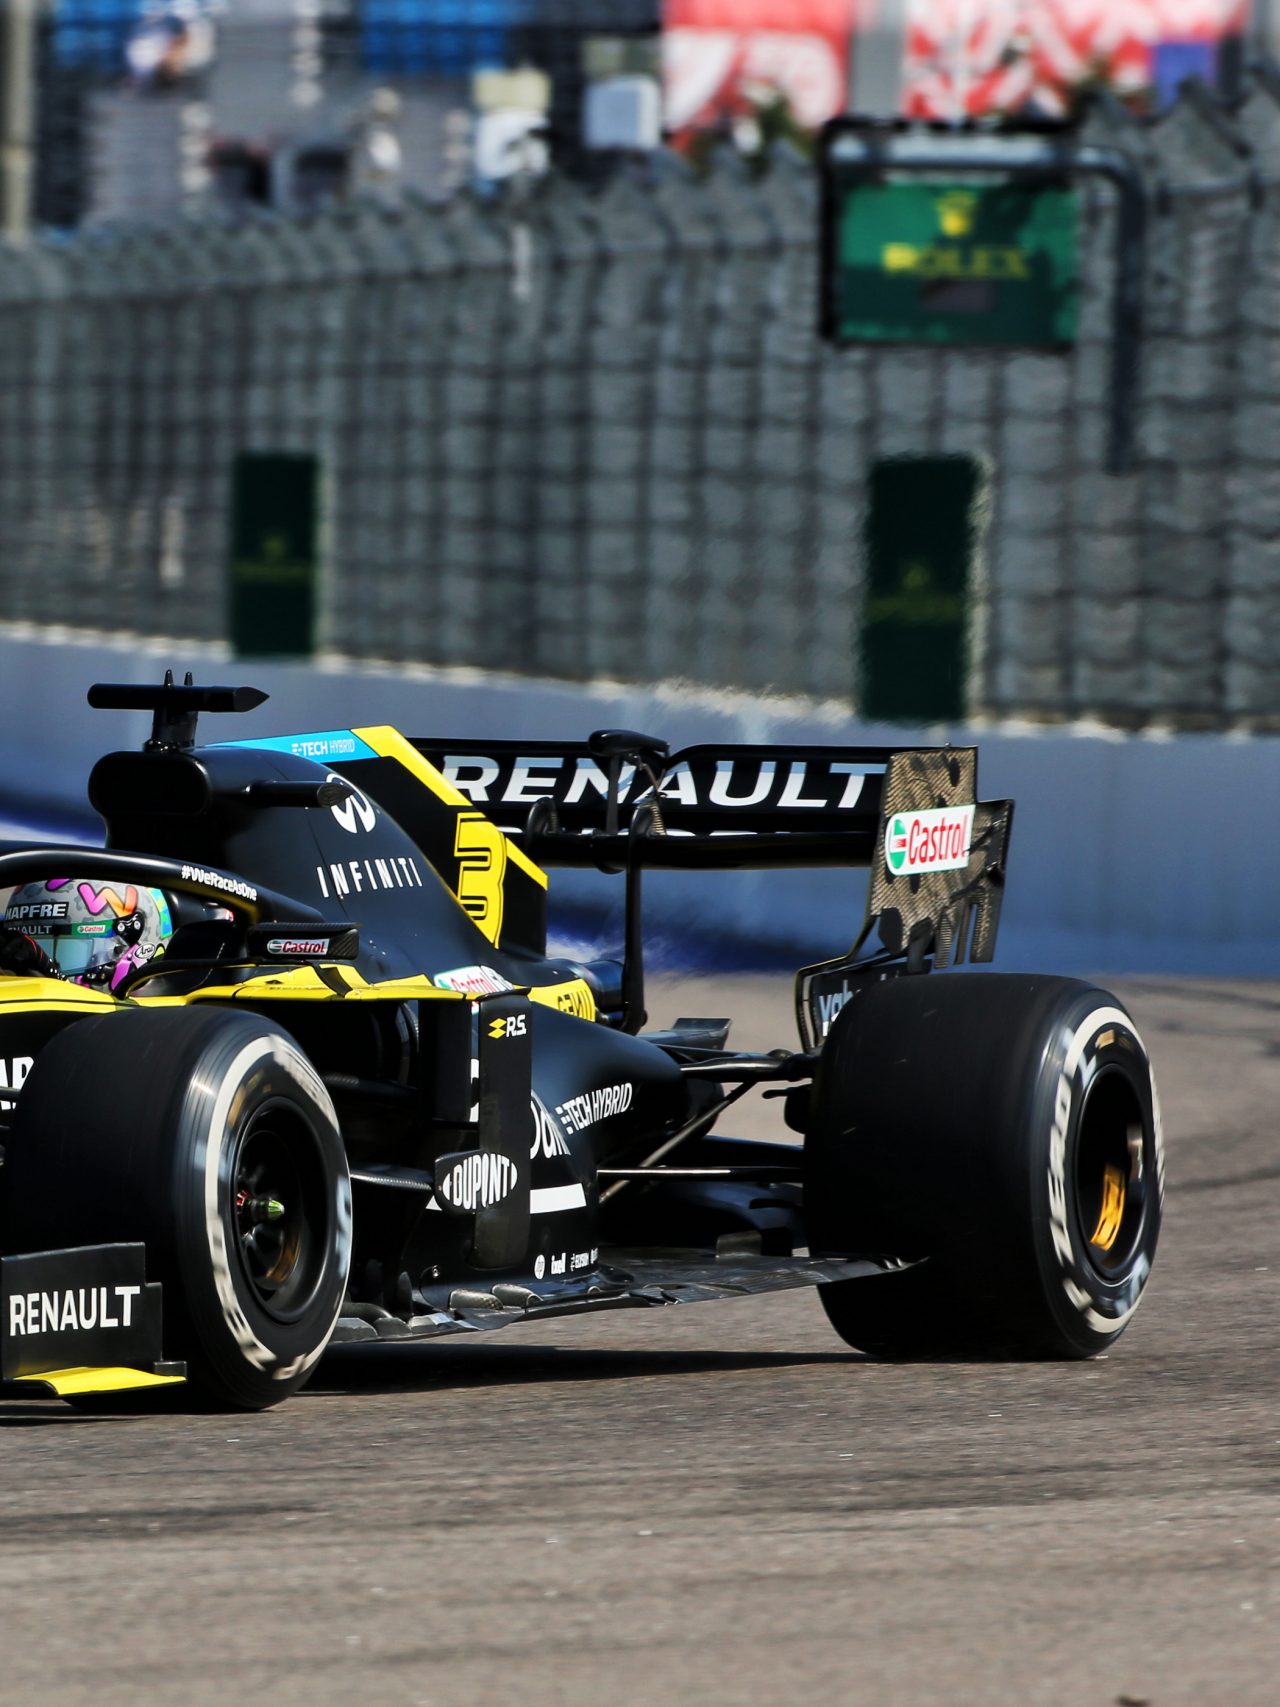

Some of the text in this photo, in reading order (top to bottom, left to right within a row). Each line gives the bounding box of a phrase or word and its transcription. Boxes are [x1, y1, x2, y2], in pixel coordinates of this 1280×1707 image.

[442, 755, 888, 809] RENAULT
[908, 814, 970, 865] Castrol
[181, 865, 257, 902] #WeRaceAsOne
[316, 857, 423, 899] INFINITI
[454, 812, 507, 949] 3
[282, 939, 326, 954] Castrol
[591, 1082, 633, 1122] HYBRID
[453, 1153, 510, 1210] DUPONT
[8, 1285, 140, 1337] RENAULT
